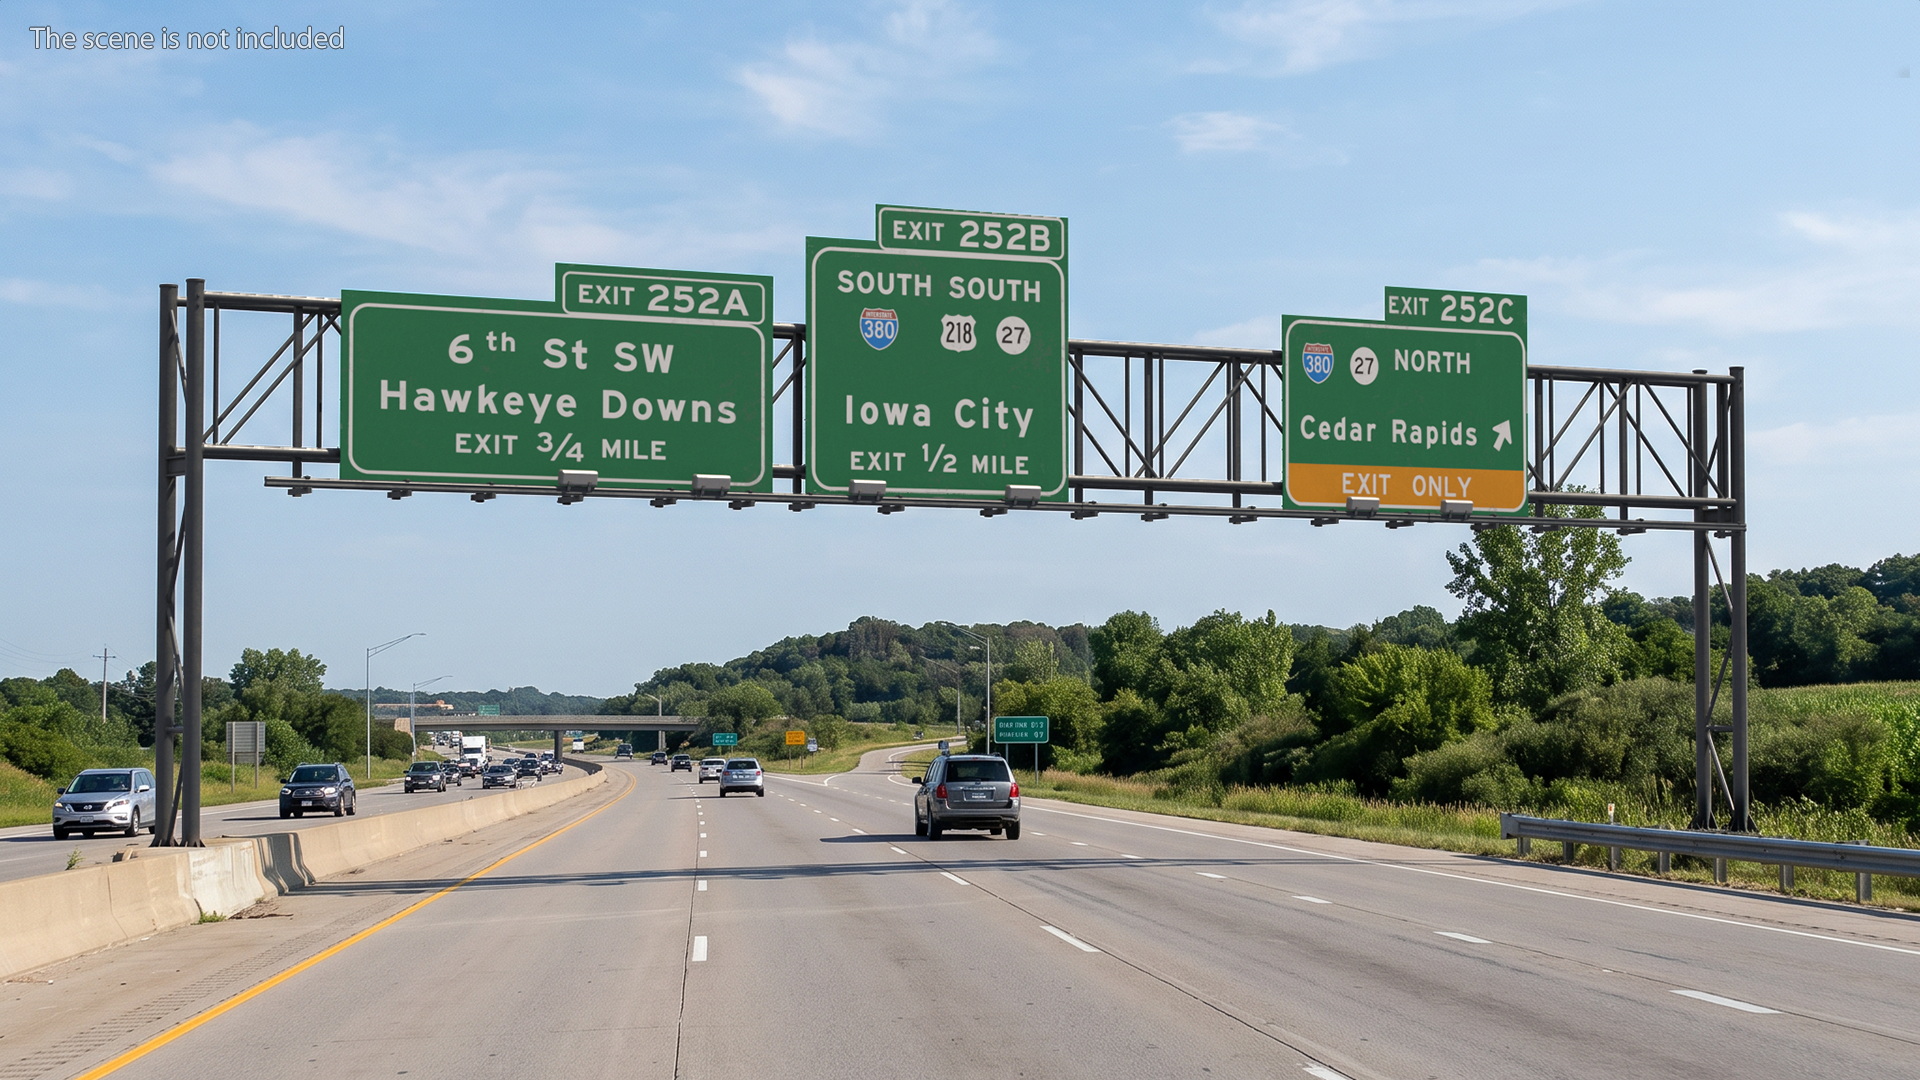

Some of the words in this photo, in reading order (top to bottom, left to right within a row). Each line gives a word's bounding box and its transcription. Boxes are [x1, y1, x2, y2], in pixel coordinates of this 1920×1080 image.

[893, 220, 944, 242] EXIT
[960, 220, 1050, 252] 252B
[578, 284, 635, 306] EXIT
[647, 283, 749, 317] 252A
[837, 270, 932, 297] SOUTH
[949, 276, 1041, 302] SOUTH
[1389, 295, 1429, 315] EXIT
[1441, 294, 1514, 325] 252C
[864, 320, 894, 340] 380
[946, 321, 972, 344] 218
[1002, 326, 1024, 344] 27
[543, 338, 588, 370] St
[613, 342, 674, 374] SW
[1306, 356, 1330, 374] 380
[1354, 357, 1374, 374] 27
[1394, 349, 1470, 374] NORTH
[380, 379, 578, 424] Hawkeye
[602, 389, 737, 425] Downs
[846, 395, 931, 427] Iowa
[955, 397, 1033, 438] City
[455, 433, 518, 456] EXIT
[536, 431, 584, 463] 3/4
[602, 439, 667, 461] MILE
[1300, 415, 1376, 442] Cedar
[1392, 419, 1477, 450] Rapids
[850, 451, 906, 472] EXIT
[922, 443, 957, 474] 1/2
[972, 455, 1029, 475] MILE
[1342, 473, 1391, 495] EXIT
[1413, 475, 1472, 498] ONLY
